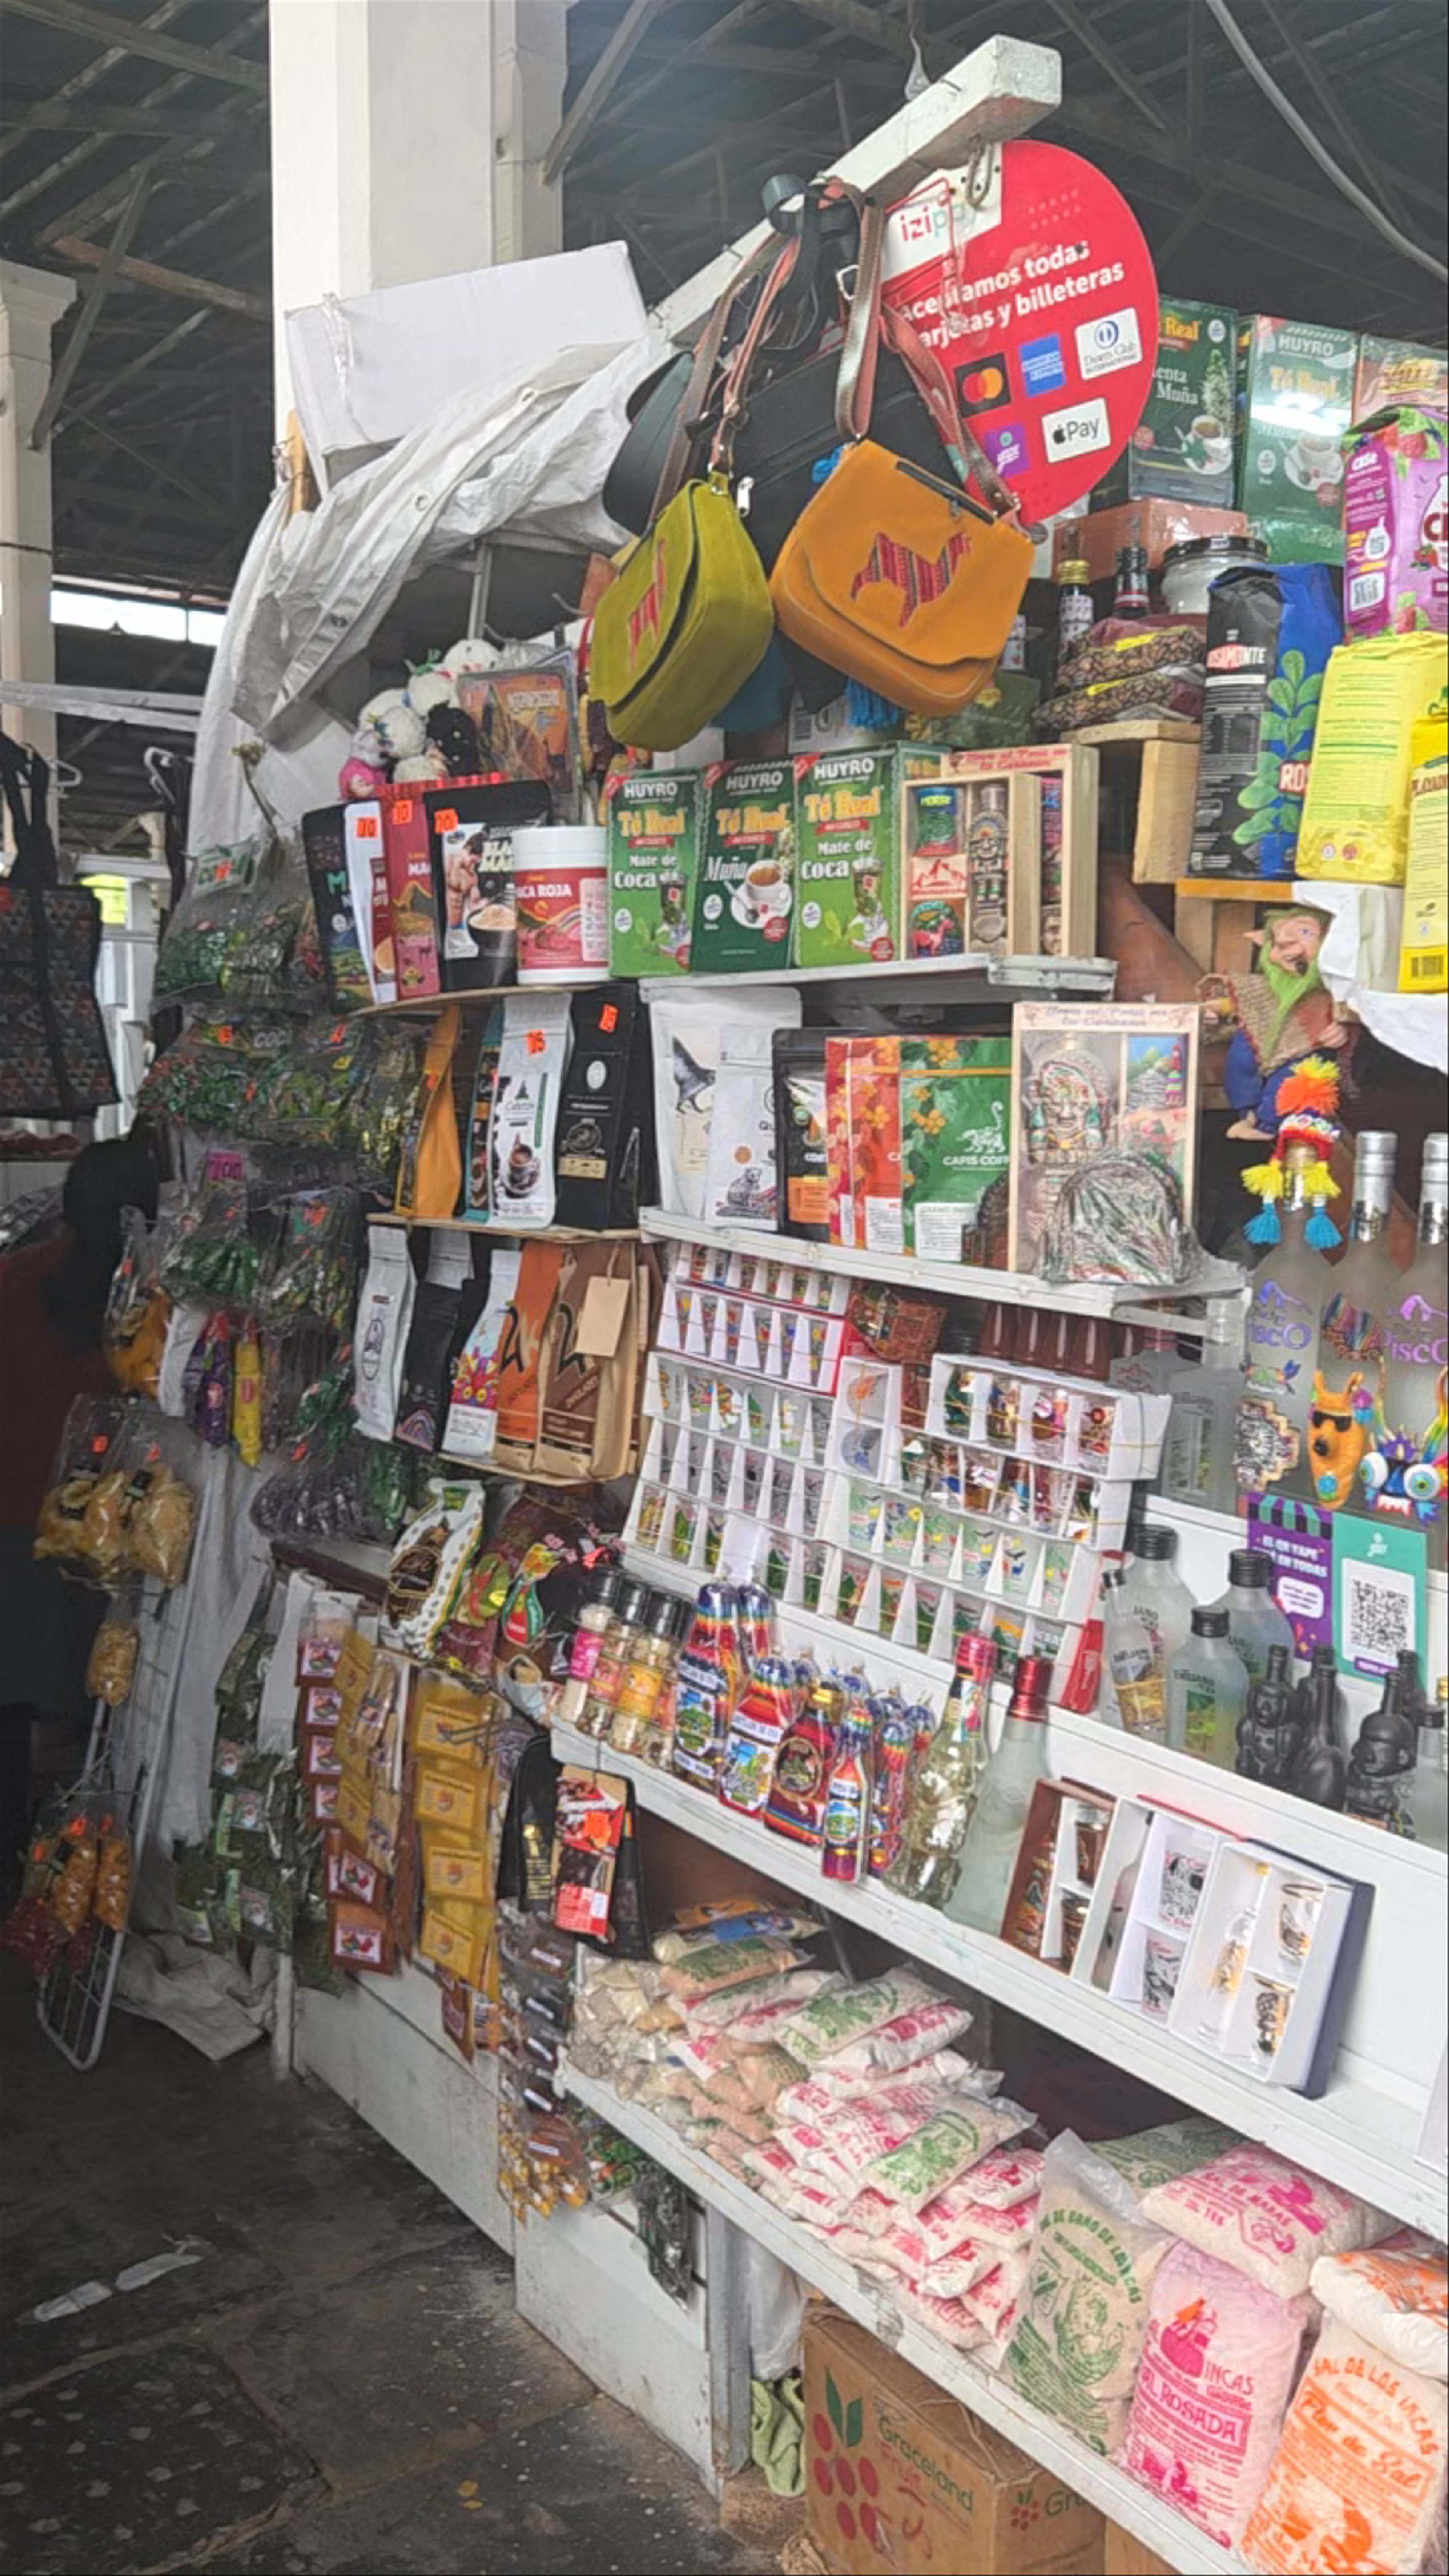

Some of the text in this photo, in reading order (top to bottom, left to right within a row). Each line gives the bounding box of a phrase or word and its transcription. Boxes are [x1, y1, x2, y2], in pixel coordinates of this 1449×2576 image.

[1024, 241, 1090, 278] todas
[919, 262, 1125, 348] arjas y billeteras
[1278, 334, 1335, 356] HUYRO
[1155, 367, 1187, 383] enta
[1066, 418, 1099, 441] Pay
[814, 757, 875, 780] HUYRO
[624, 781, 678, 799] HUYRO
[726, 771, 783, 790] HUYRO
[614, 870, 657, 888] Coca
[801, 860, 849, 880] Coca
[943, 1155, 979, 1166] CAPIS
[1205, 2361, 1254, 2395] INCAS
[1160, 2382, 1237, 2442] ROSADA
[878, 2415, 973, 2514] Graceland
